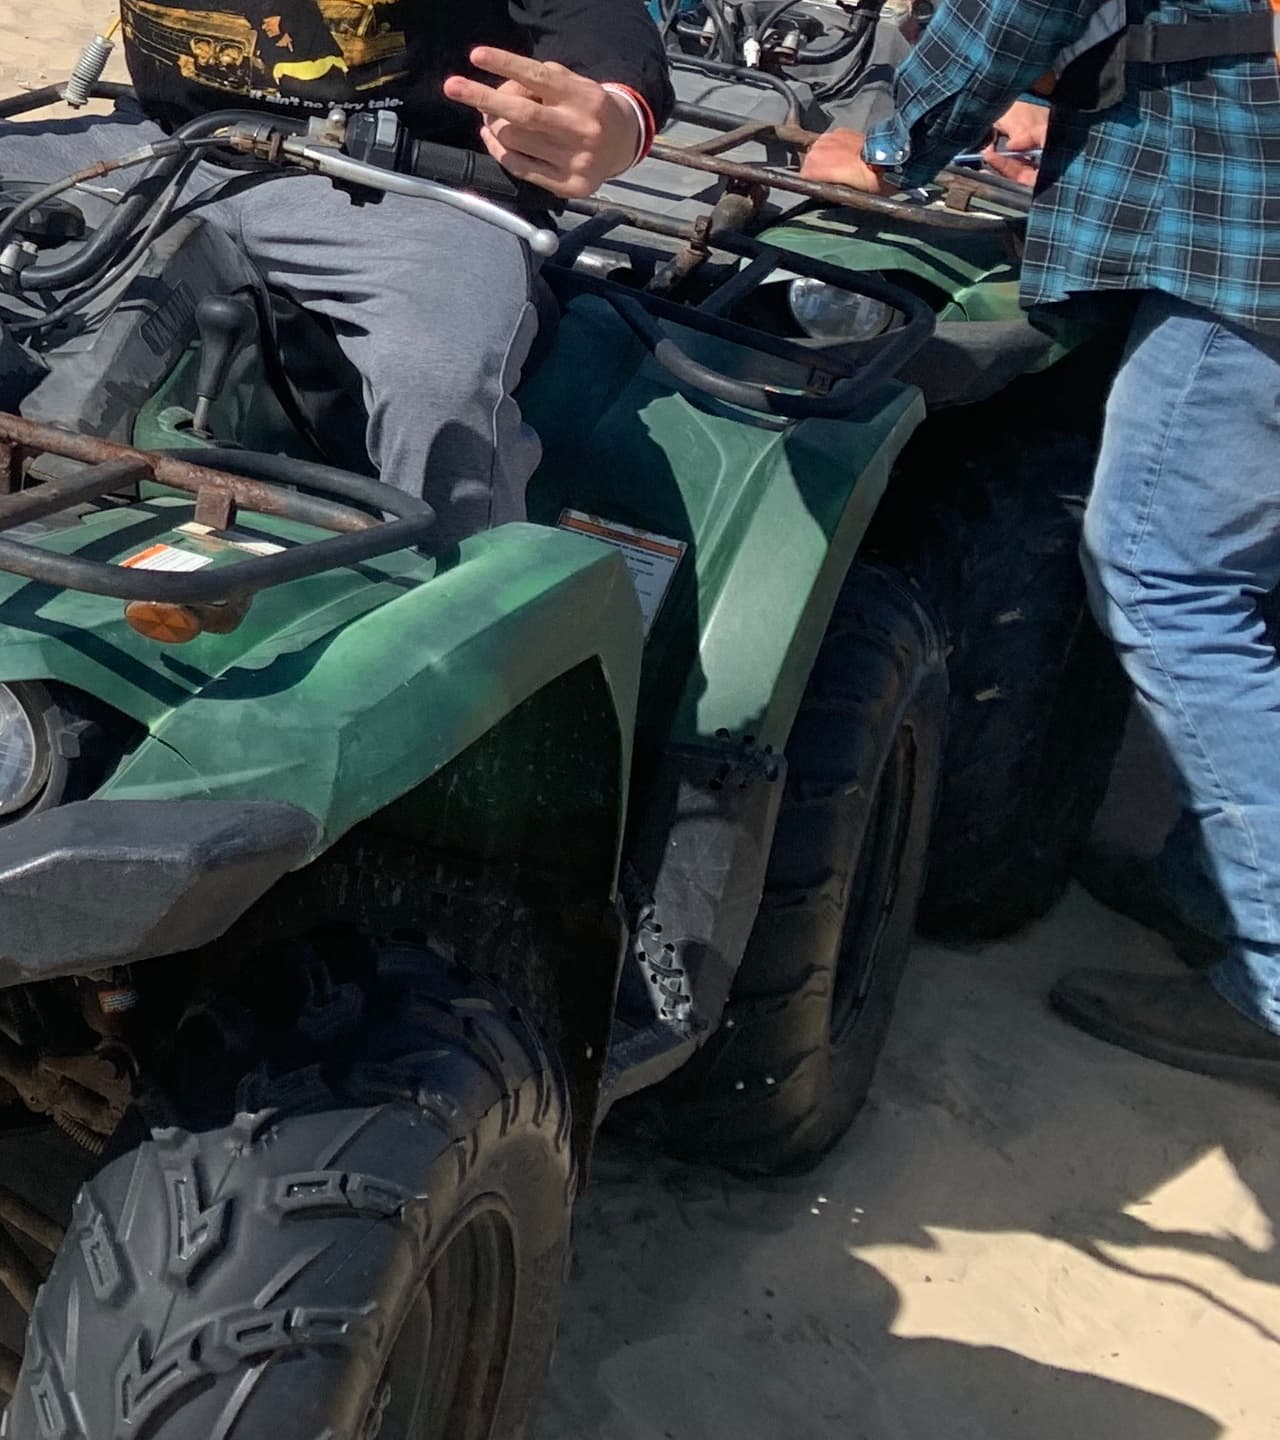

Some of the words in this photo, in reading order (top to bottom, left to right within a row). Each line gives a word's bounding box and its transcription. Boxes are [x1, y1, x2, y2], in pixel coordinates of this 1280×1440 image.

[265, 93, 301, 107] ain't
[303, 99, 324, 109] no
[327, 101, 364, 110] fairy
[368, 97, 405, 109] tale.
